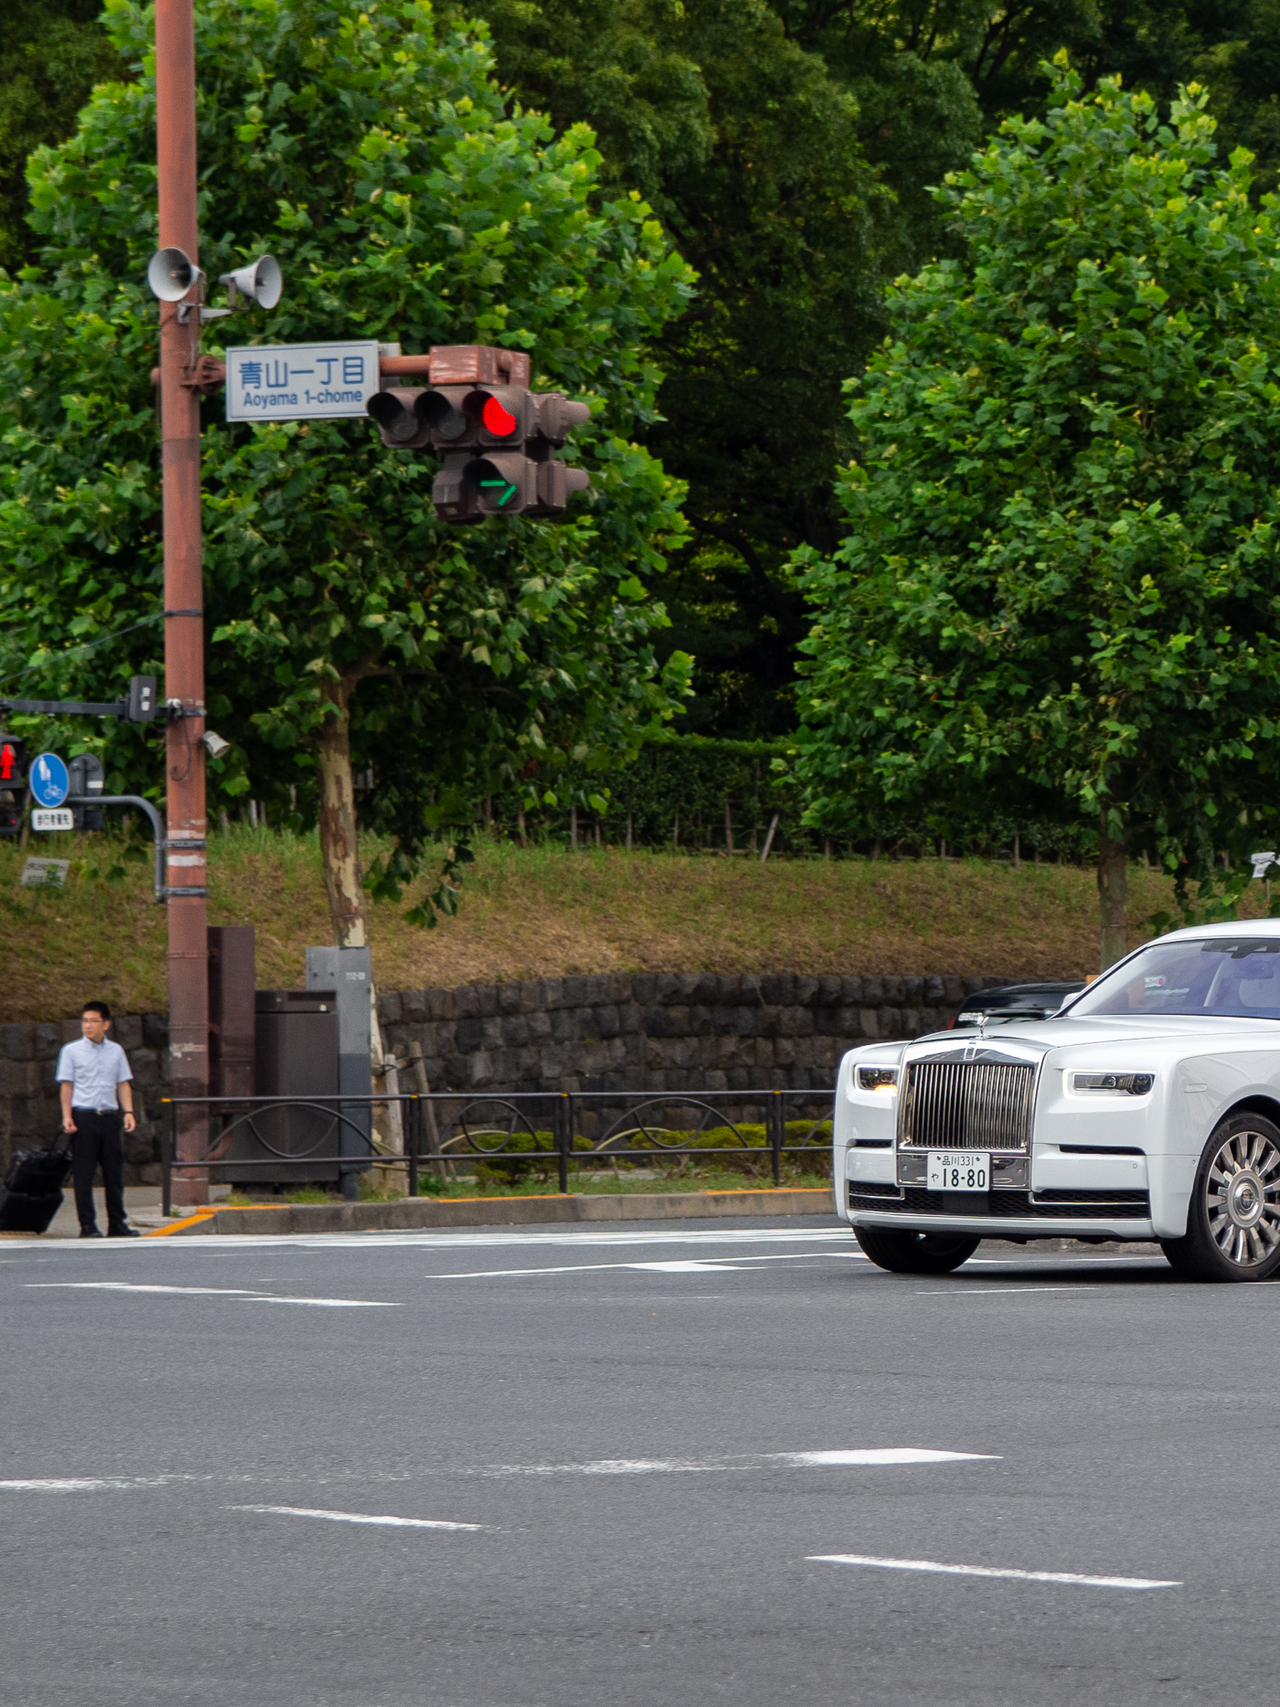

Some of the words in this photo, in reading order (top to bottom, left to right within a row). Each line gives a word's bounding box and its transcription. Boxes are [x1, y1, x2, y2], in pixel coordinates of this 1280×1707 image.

[239, 356, 364, 390] 青山一丁目
[243, 391, 298, 409] Aoyama
[304, 388, 363, 404] 1-chome
[942, 1168, 986, 1188] 18-80
